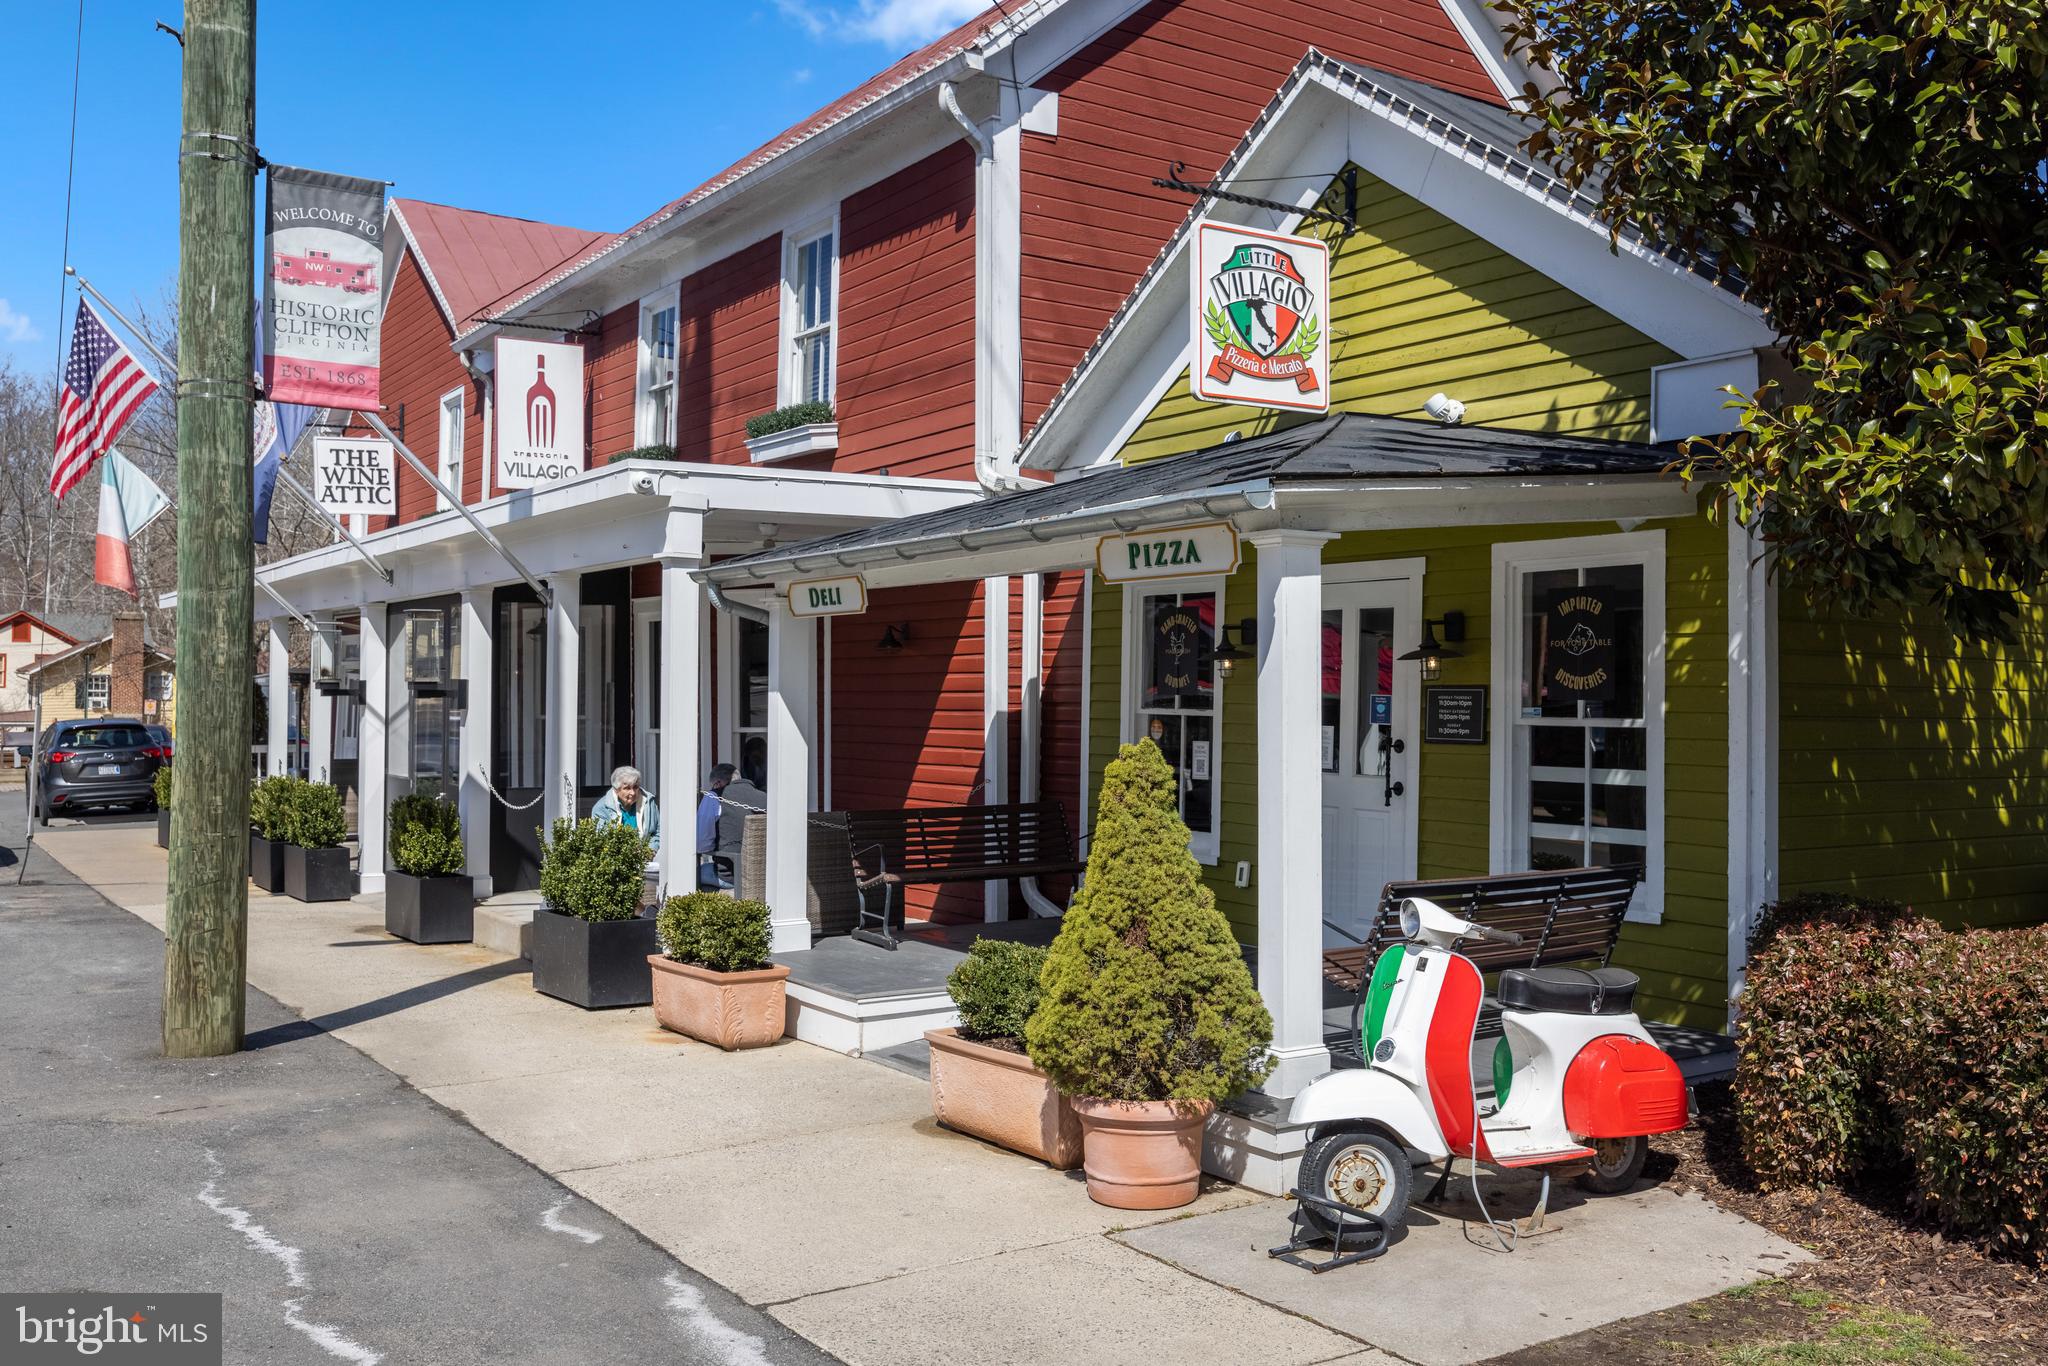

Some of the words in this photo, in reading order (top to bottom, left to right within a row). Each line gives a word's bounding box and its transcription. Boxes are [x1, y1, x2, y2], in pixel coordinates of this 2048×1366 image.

[274, 207, 355, 227] WELCOME
[357, 218, 378, 236] TO
[305, 262, 324, 272] NW
[1240, 251, 1287, 272] LITTLE
[1217, 271, 1307, 313] VILLAGIO
[270, 298, 375, 325] HISTORIC
[274, 317, 369, 342] CLIFTON
[274, 333, 370, 352] VIRGINIA
[1226, 346, 1260, 373] Pizzeria
[1261, 364, 1268, 374] e
[1268, 360, 1303, 375] Mercato
[280, 364, 320, 381] EST.
[327, 369, 366, 386] 1868
[329, 448, 380, 468] THE
[513, 450, 569, 460] trattoria
[321, 466, 390, 486] WINE
[503, 461, 579, 480] VILLAGIO
[321, 485, 392, 505] ATTIC
[1127, 539, 1202, 570] PIZZA
[808, 587, 842, 608] DELI
[1557, 596, 1603, 617] IMPORTED
[1590, 638, 1613, 646] TABLE
[1555, 668, 1607, 690] DISCOVERIES
